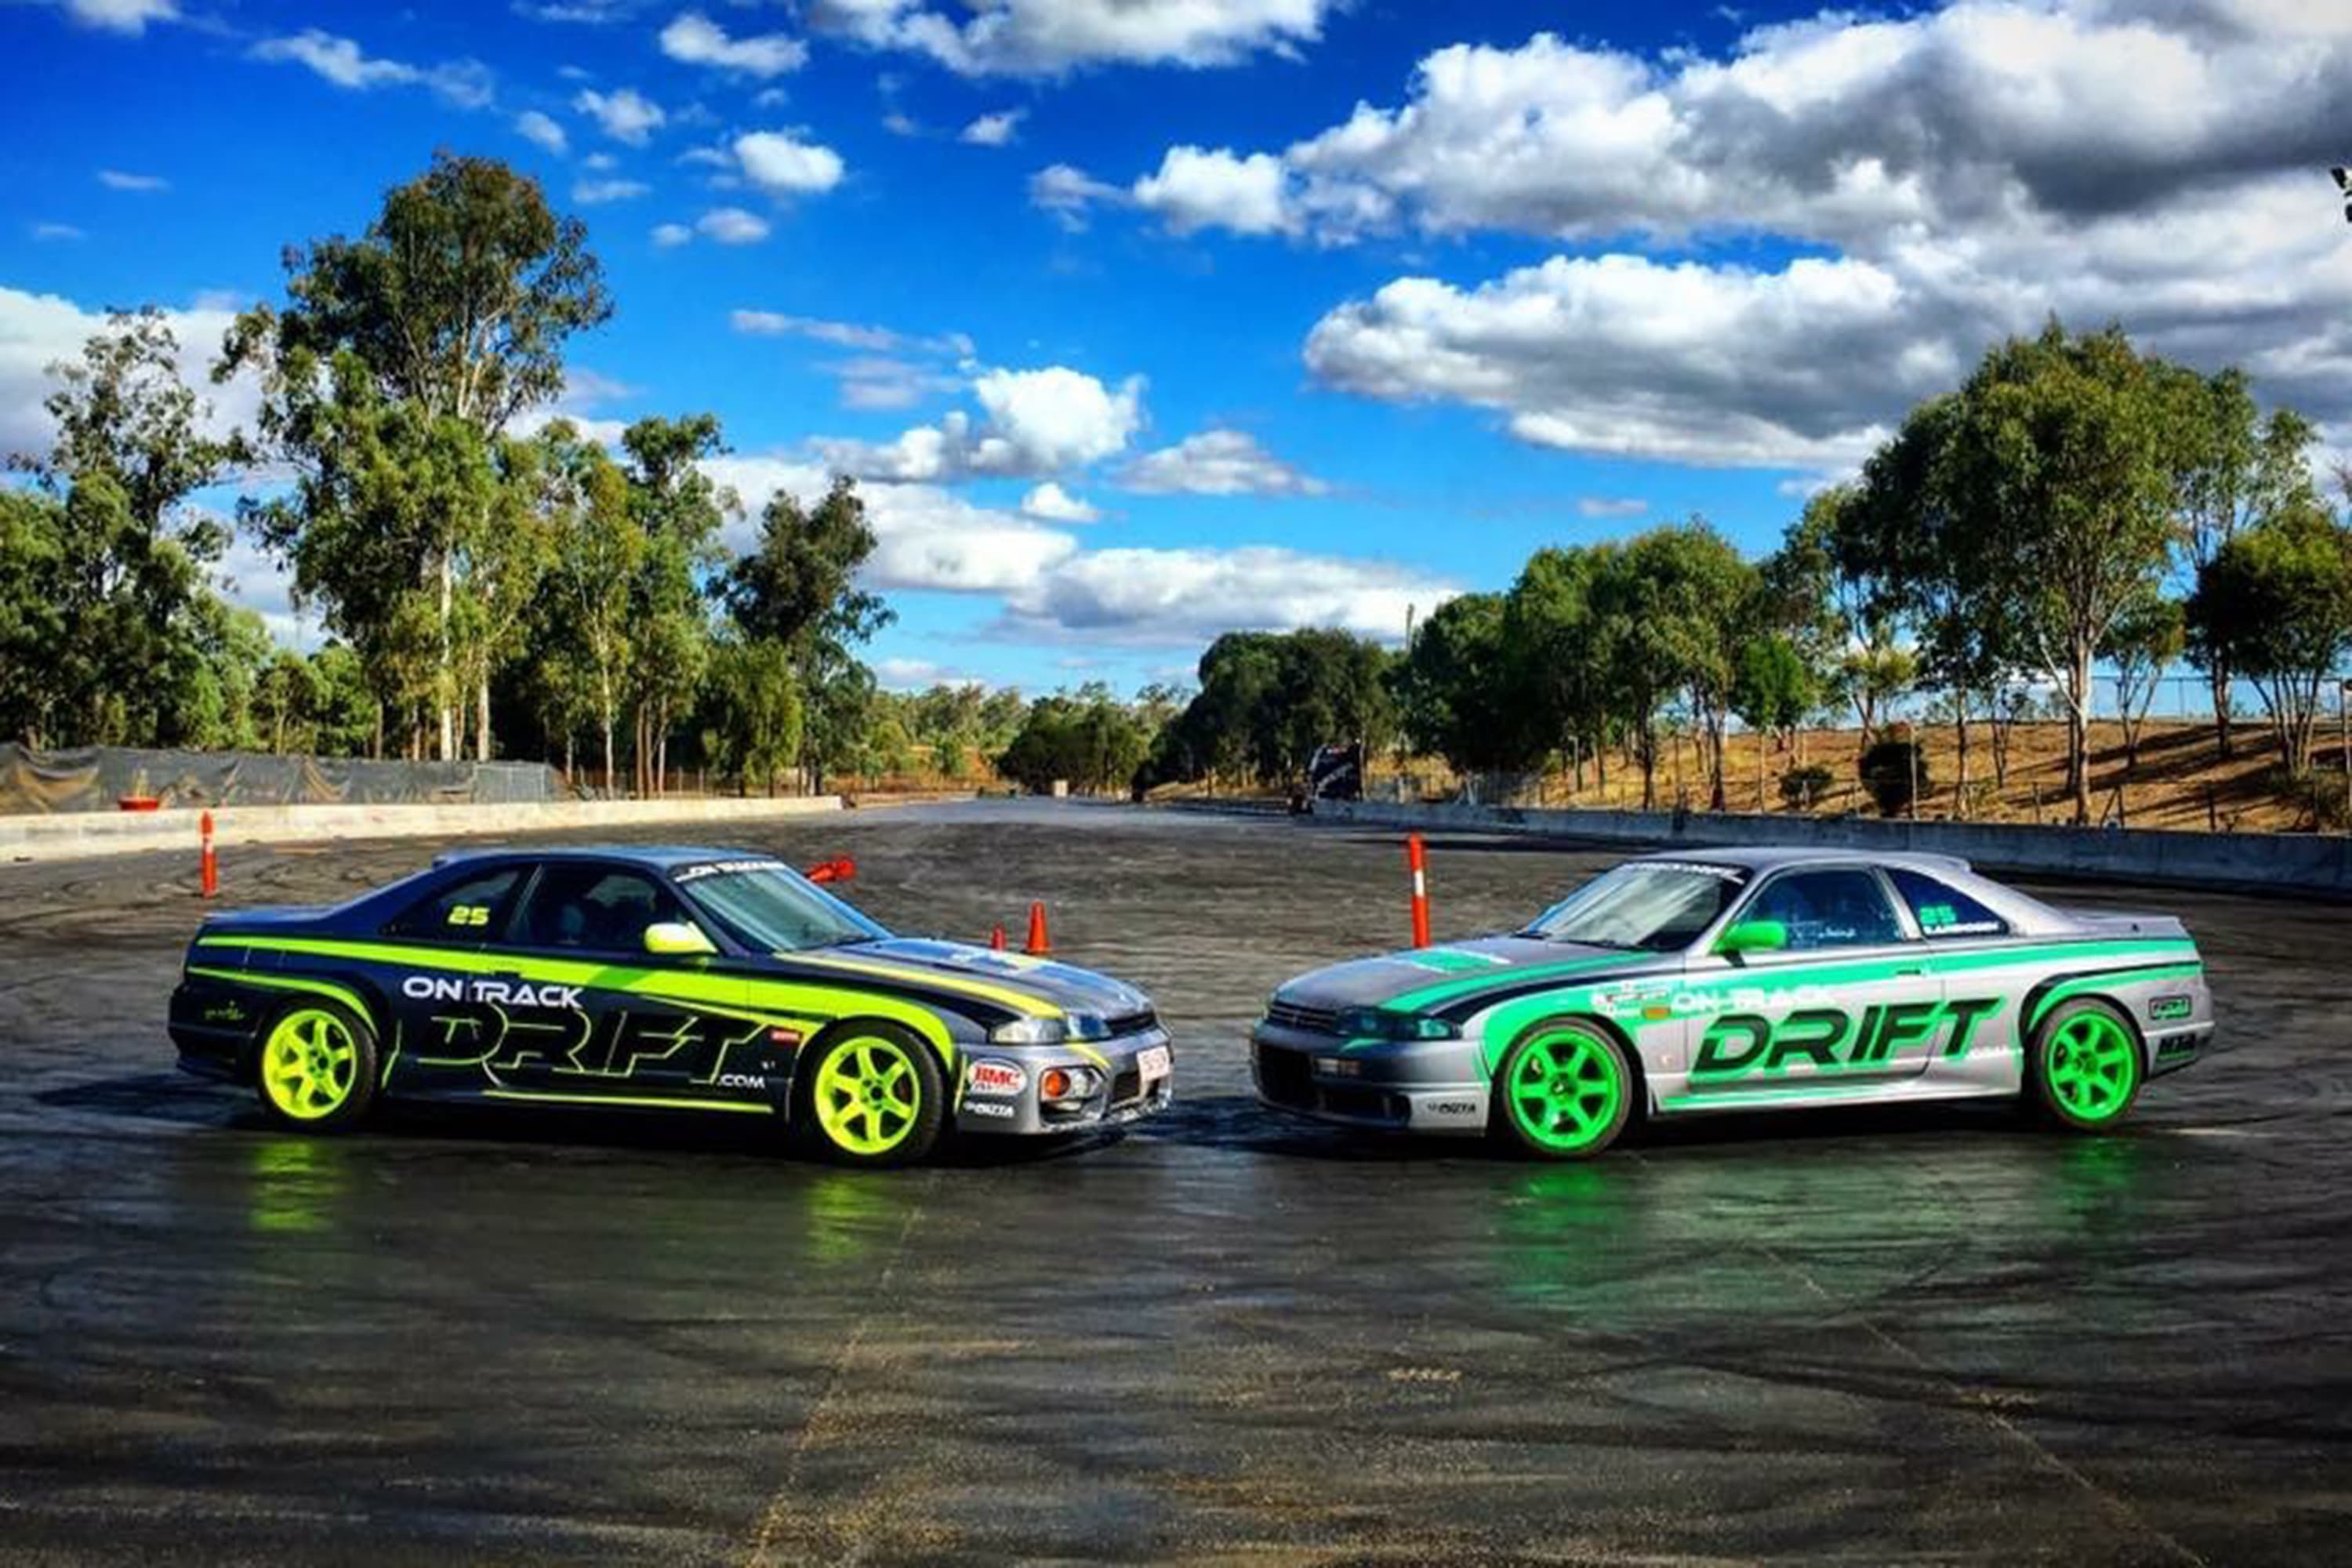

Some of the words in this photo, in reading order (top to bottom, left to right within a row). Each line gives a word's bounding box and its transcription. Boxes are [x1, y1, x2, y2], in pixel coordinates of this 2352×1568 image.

[403, 977, 463, 1000] ON
[472, 980, 583, 1009] TRACK
[416, 997, 768, 1084] DRIFT
[1689, 996, 2005, 1078] DRIFT
